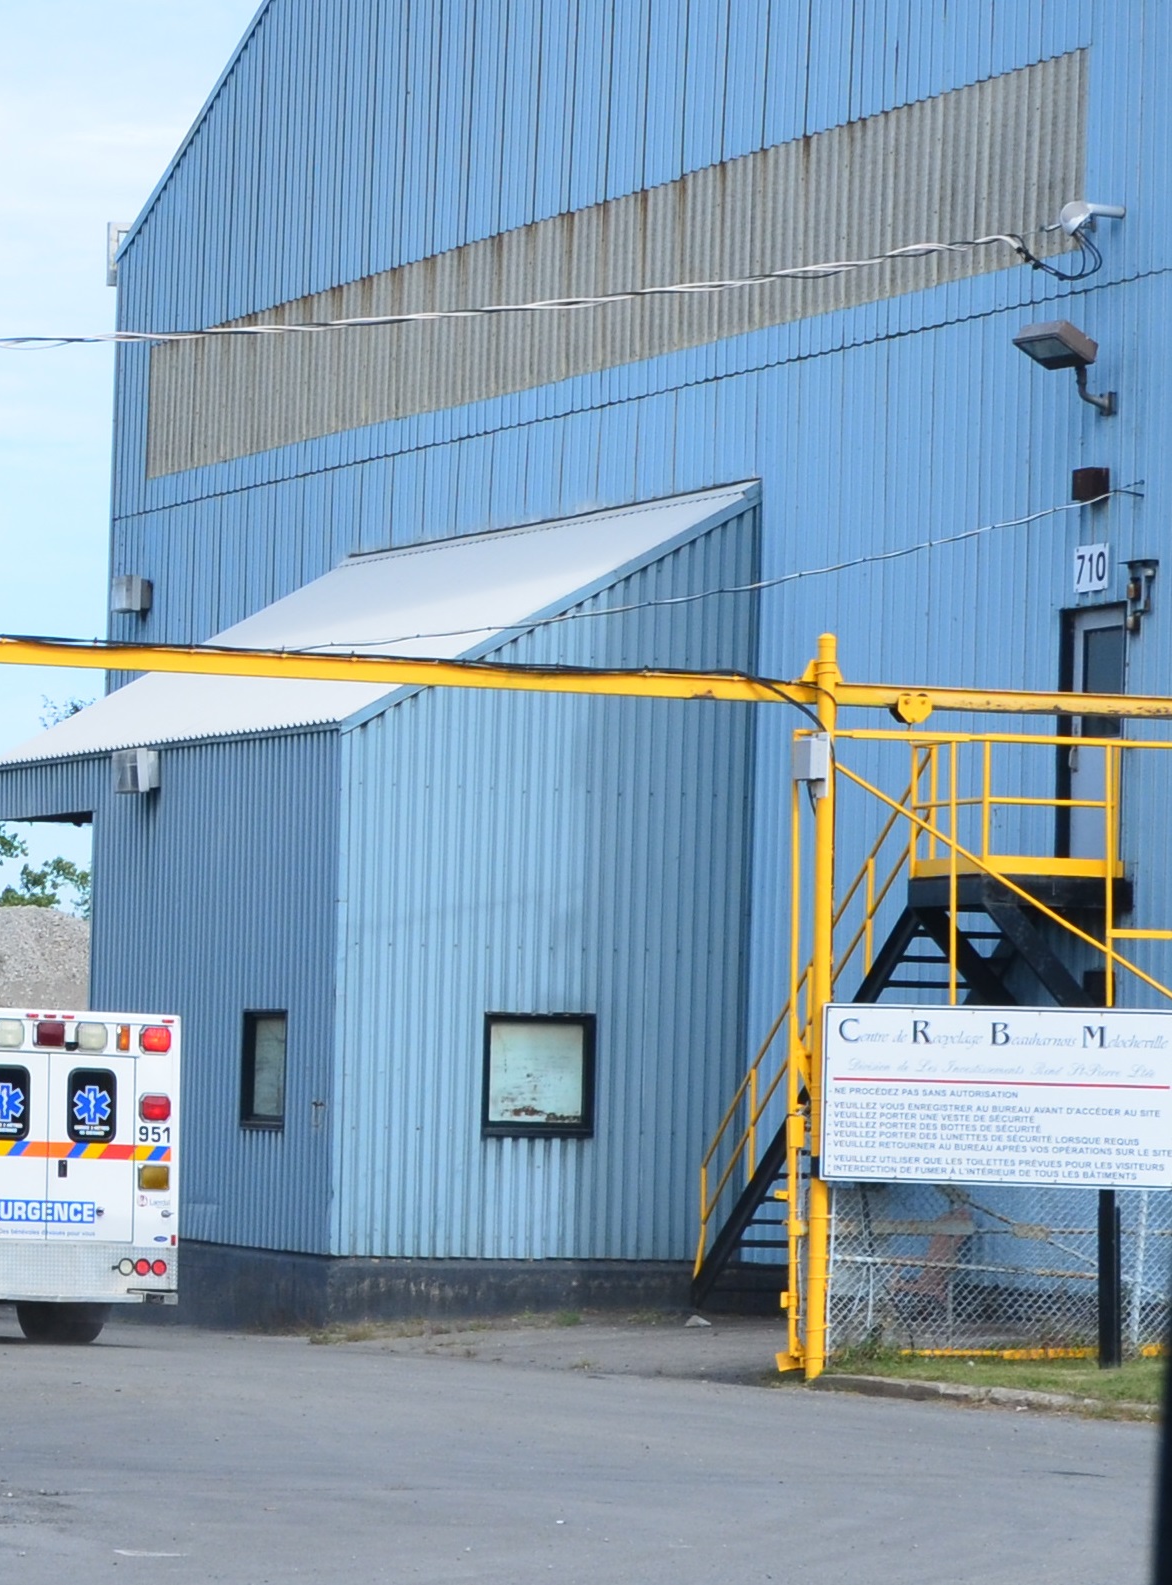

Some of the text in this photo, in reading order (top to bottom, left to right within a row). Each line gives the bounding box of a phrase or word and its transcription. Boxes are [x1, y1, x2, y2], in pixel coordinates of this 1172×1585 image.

[1077, 551, 1106, 584] 710
[838, 1018, 1168, 1049] Centre de Recyclage Beauharnois Melocheville
[897, 1059, 909, 1071] de
[849, 1087, 899, 1096] PROCÉDEZ
[902, 1088, 919, 1096] PAS
[949, 1089, 1019, 1099] AUTORISATION
[834, 1101, 877, 1110] VEUILLEZ
[908, 1103, 973, 1112] ENREGISTRER
[991, 1105, 1031, 1114] BUREAU
[1140, 1110, 1161, 1118] SITE
[834, 1111, 877, 1119] VEUILLEZ
[879, 1112, 917, 1120] PORTER
[919, 1113, 938, 1121] UNE
[940, 1114, 970, 1122] VESTE
[988, 1114, 1035, 1123] SÉCURITÉ
[139, 1125, 171, 1143] 951
[834, 1121, 1041, 1133] VEUILLEZ PORTER DES BOTTES DE SÉCURITÉ
[834, 1130, 876, 1138] VEUILLEZ
[879, 1131, 916, 1139] PORTER
[919, 1132, 937, 1140] DES
[940, 1133, 988, 1142] LUNETTES
[1006, 1134, 1052, 1143] SÉCURITÉ
[1055, 1136, 1101, 1145] LORSQUE
[1104, 1137, 1140, 1146] REQUIS
[834, 1140, 876, 1148] VEUILLEZ
[878, 1141, 935, 1150] RETOURNER
[954, 1144, 993, 1152] BUREAU
[1030, 1146, 1049, 1154] VOS
[1115, 1148, 1135, 1156] SUR
[1152, 1149, 1172, 1158] SITE
[834, 1154, 877, 1163] VEUILLEZ
[879, 1155, 920, 1164] UTILISER
[923, 1156, 942, 1165] QUE
[966, 1158, 1015, 1167] TOILETTES
[1065, 1161, 1092, 1169] POUR
[1095, 1162, 1112, 1170] LES
[1115, 1163, 1165, 1171] VISITEURS
[834, 1164, 897, 1173] INTERDICTION
[900, 1166, 912, 1174] DE
[915, 1166, 947, 1175] FUMER
[1018, 1169, 1031, 1177] DE
[1035, 1170, 1059, 1178] TOUS
[0, 1201, 94, 1222] URGENCE
